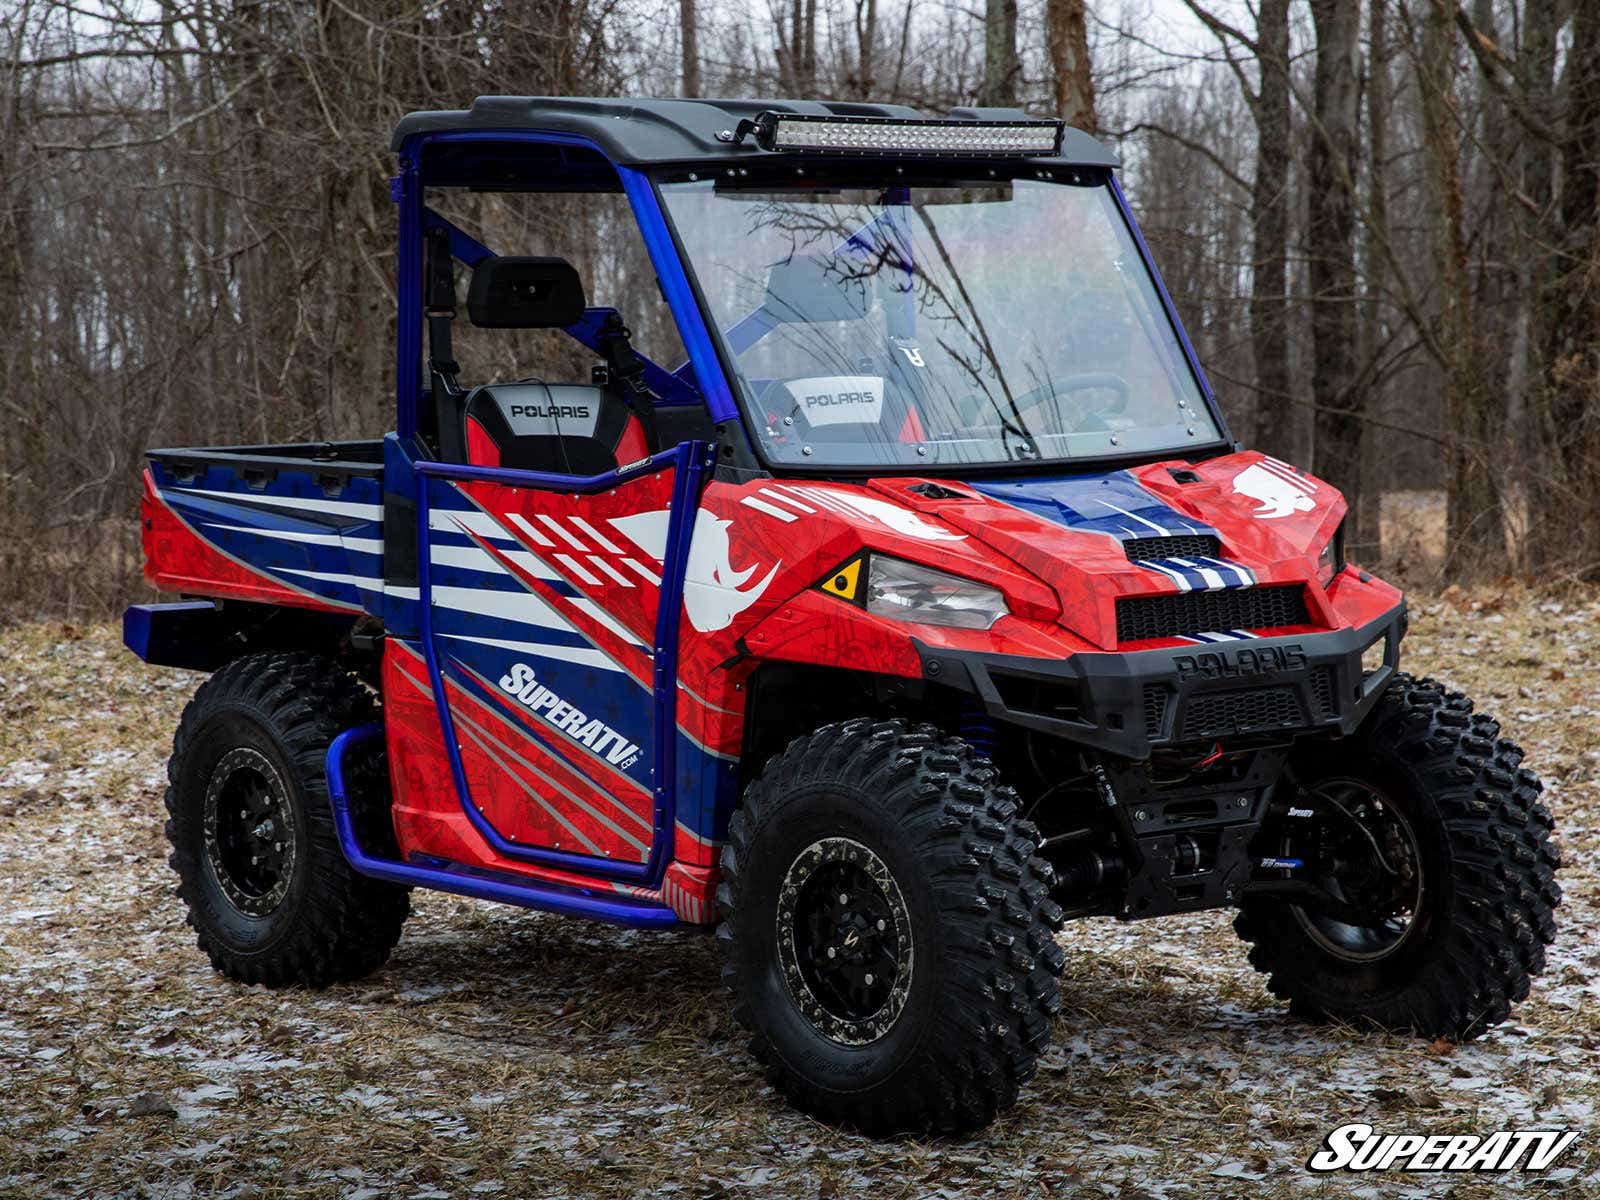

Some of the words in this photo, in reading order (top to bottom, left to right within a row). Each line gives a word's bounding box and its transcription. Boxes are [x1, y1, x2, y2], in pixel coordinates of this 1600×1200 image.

[806, 391, 875, 408] POLARIS
[511, 405, 590, 418] POLARIS
[1172, 644, 1307, 682] POLARIS
